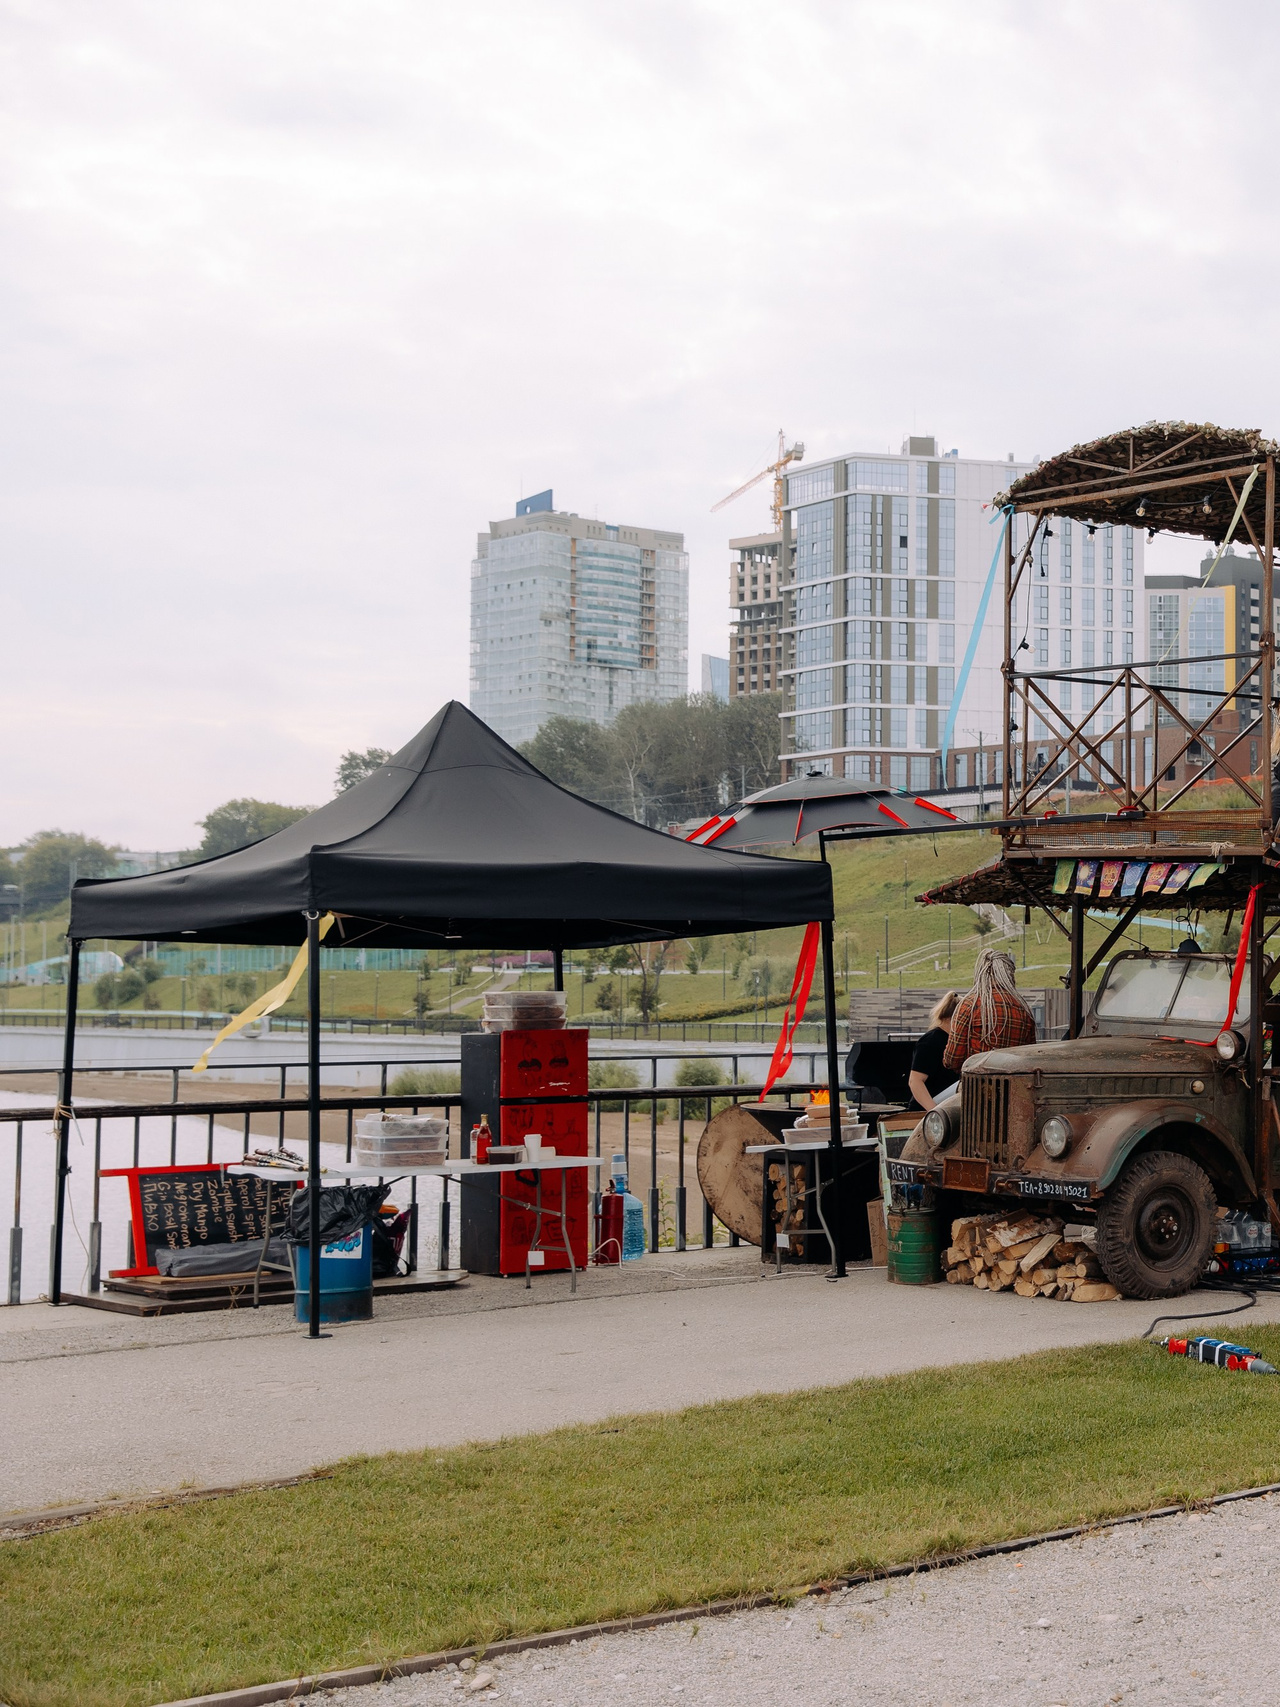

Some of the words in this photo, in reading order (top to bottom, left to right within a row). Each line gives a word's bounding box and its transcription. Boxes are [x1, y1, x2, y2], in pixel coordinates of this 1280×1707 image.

[891, 1164, 915, 1182] RENT
[157, 1181, 171, 1202] Gin
[173, 1181, 188, 1224] Negroni
[188, 1181, 204, 1201] Dry
[206, 1179, 223, 1223] Zombie
[219, 1178, 237, 1217] Tequila
[236, 1178, 254, 1209] Aperol
[180, 1224, 192, 1249] oran
[193, 1203, 209, 1240] Mango
[226, 1214, 244, 1243] sunsh
